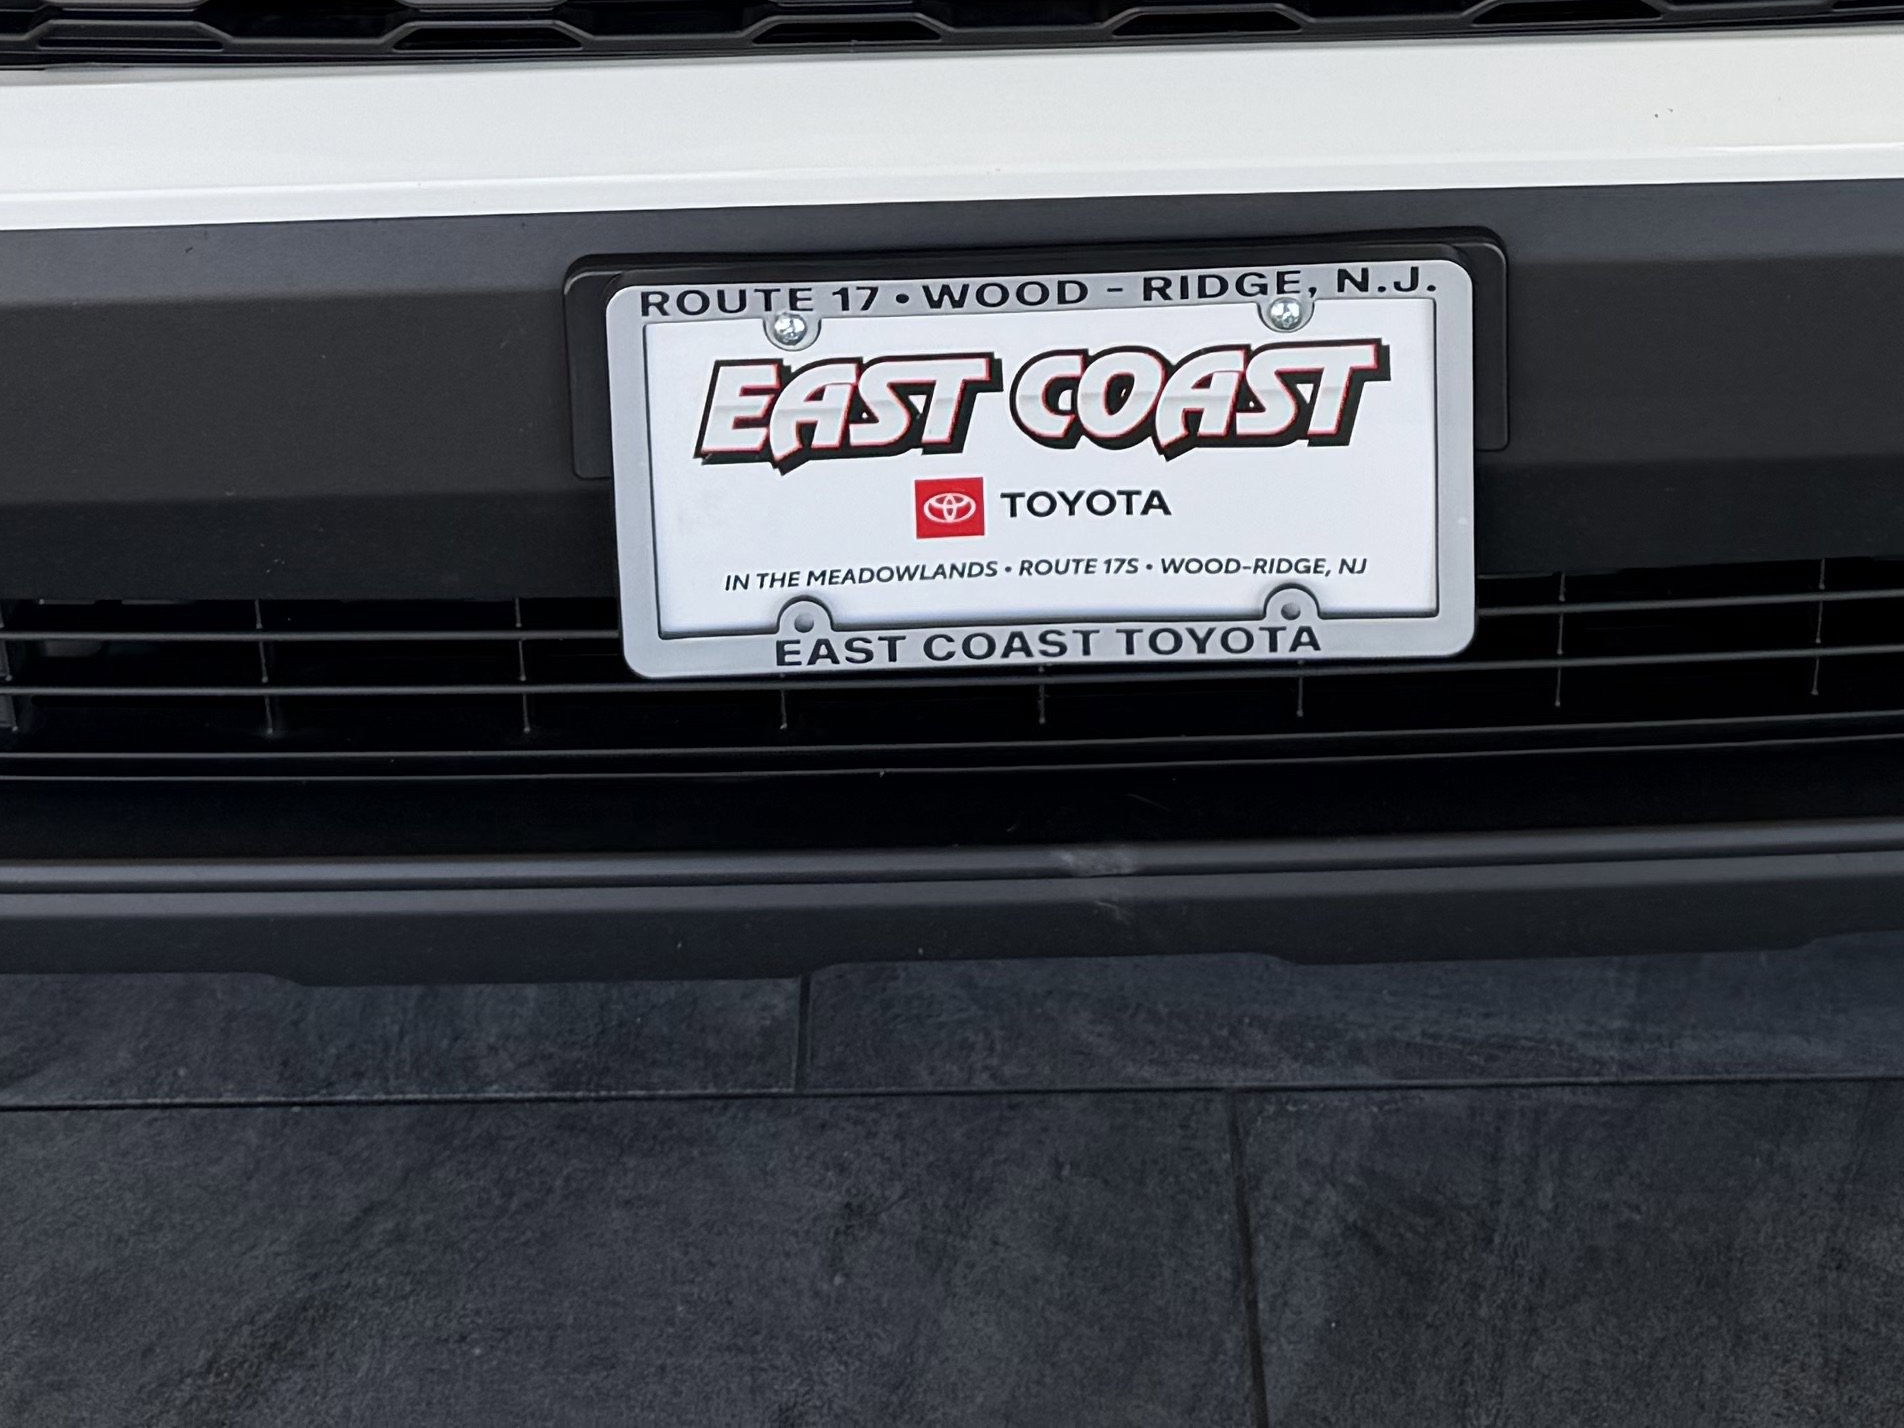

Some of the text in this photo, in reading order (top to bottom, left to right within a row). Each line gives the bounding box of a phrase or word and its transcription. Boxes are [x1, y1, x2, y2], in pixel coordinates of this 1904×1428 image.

[639, 287, 815, 317] ROUTE
[832, 285, 880, 311] 17
[921, 278, 1089, 310] WOOD
[1142, 269, 1318, 302] RIDGE,
[1337, 266, 1437, 293] N.J.
[693, 338, 1392, 476] EAST COAST
[1001, 489, 1173, 518] TOYOTA
[725, 557, 1368, 591] IN THE MEADOWLANDS ROUTE 17S WOOD-RIDGE, NJ
[775, 625, 1322, 667] EAST COAST TOYOTA
